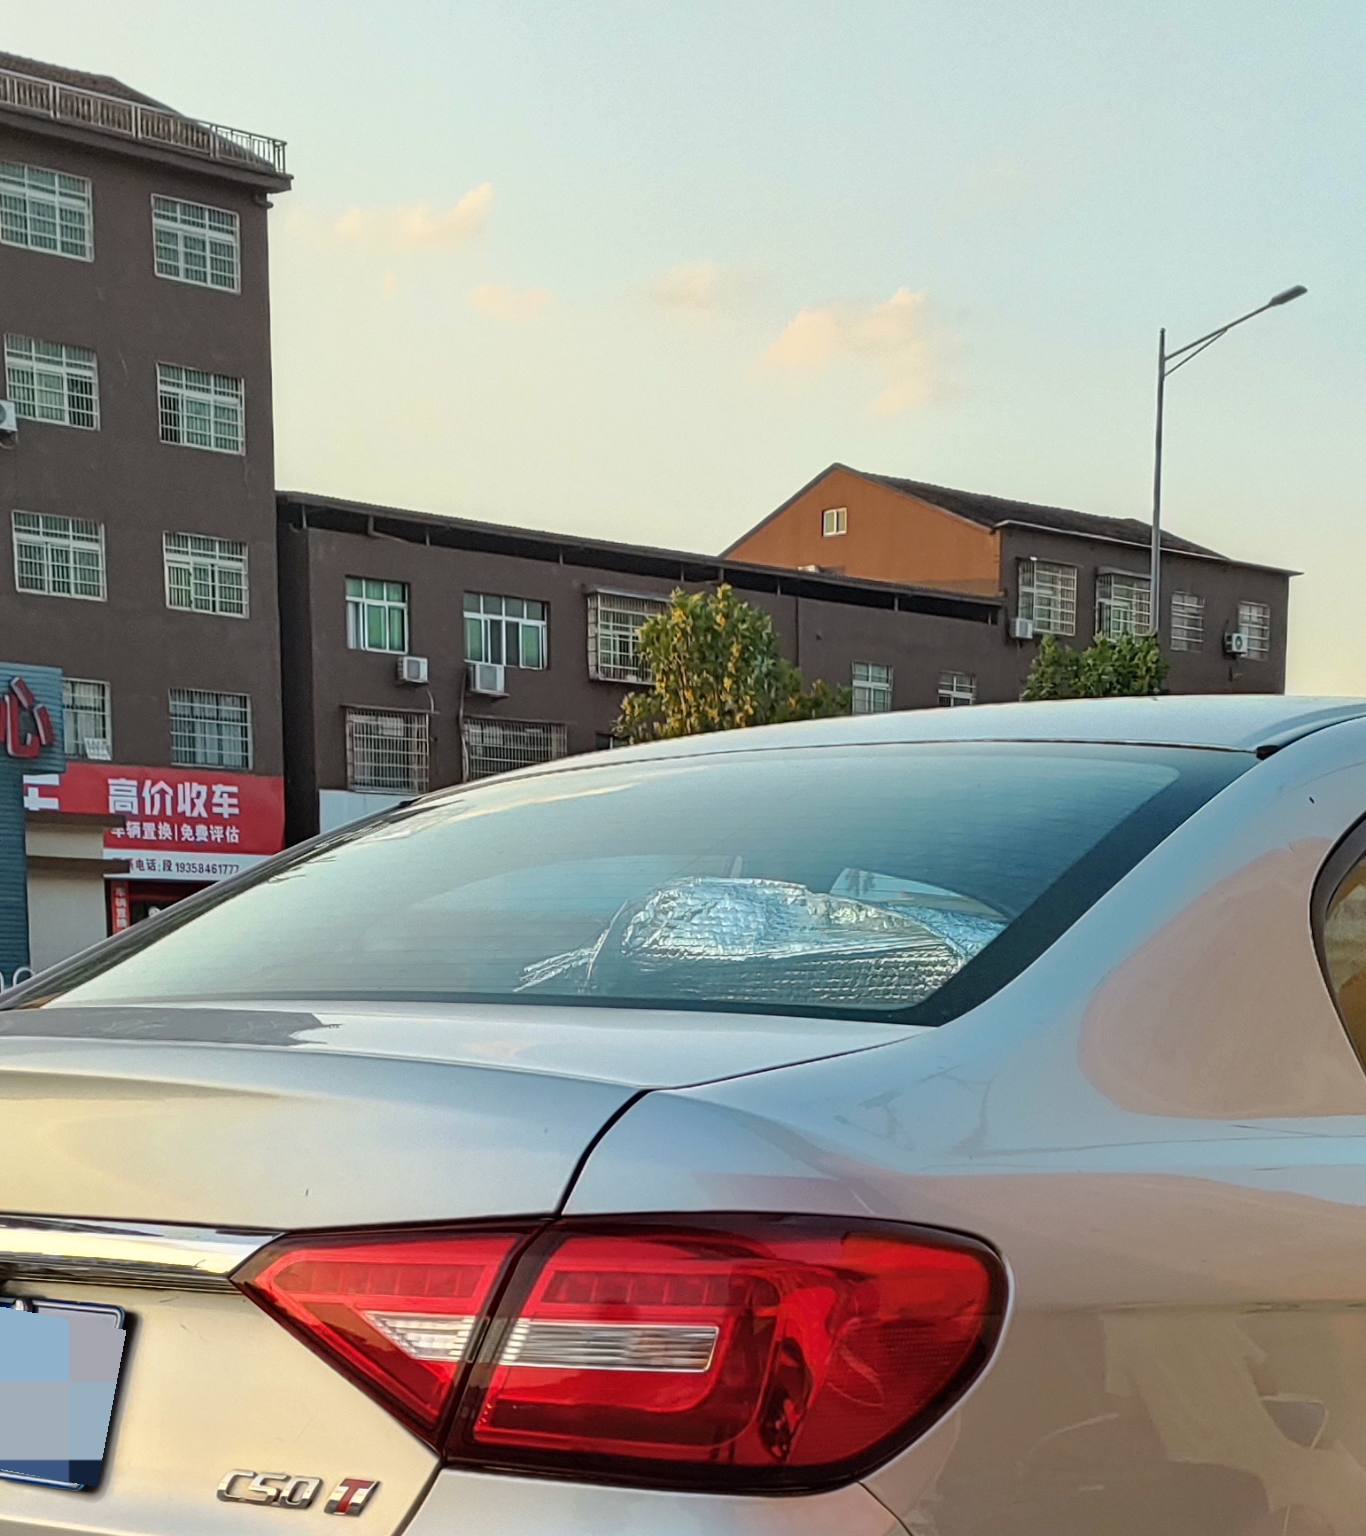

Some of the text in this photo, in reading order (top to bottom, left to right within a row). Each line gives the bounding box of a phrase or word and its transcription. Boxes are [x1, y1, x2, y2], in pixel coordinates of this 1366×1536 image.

[107, 777, 240, 819] 高价收车
[216, 1469, 380, 1517] C50 T
